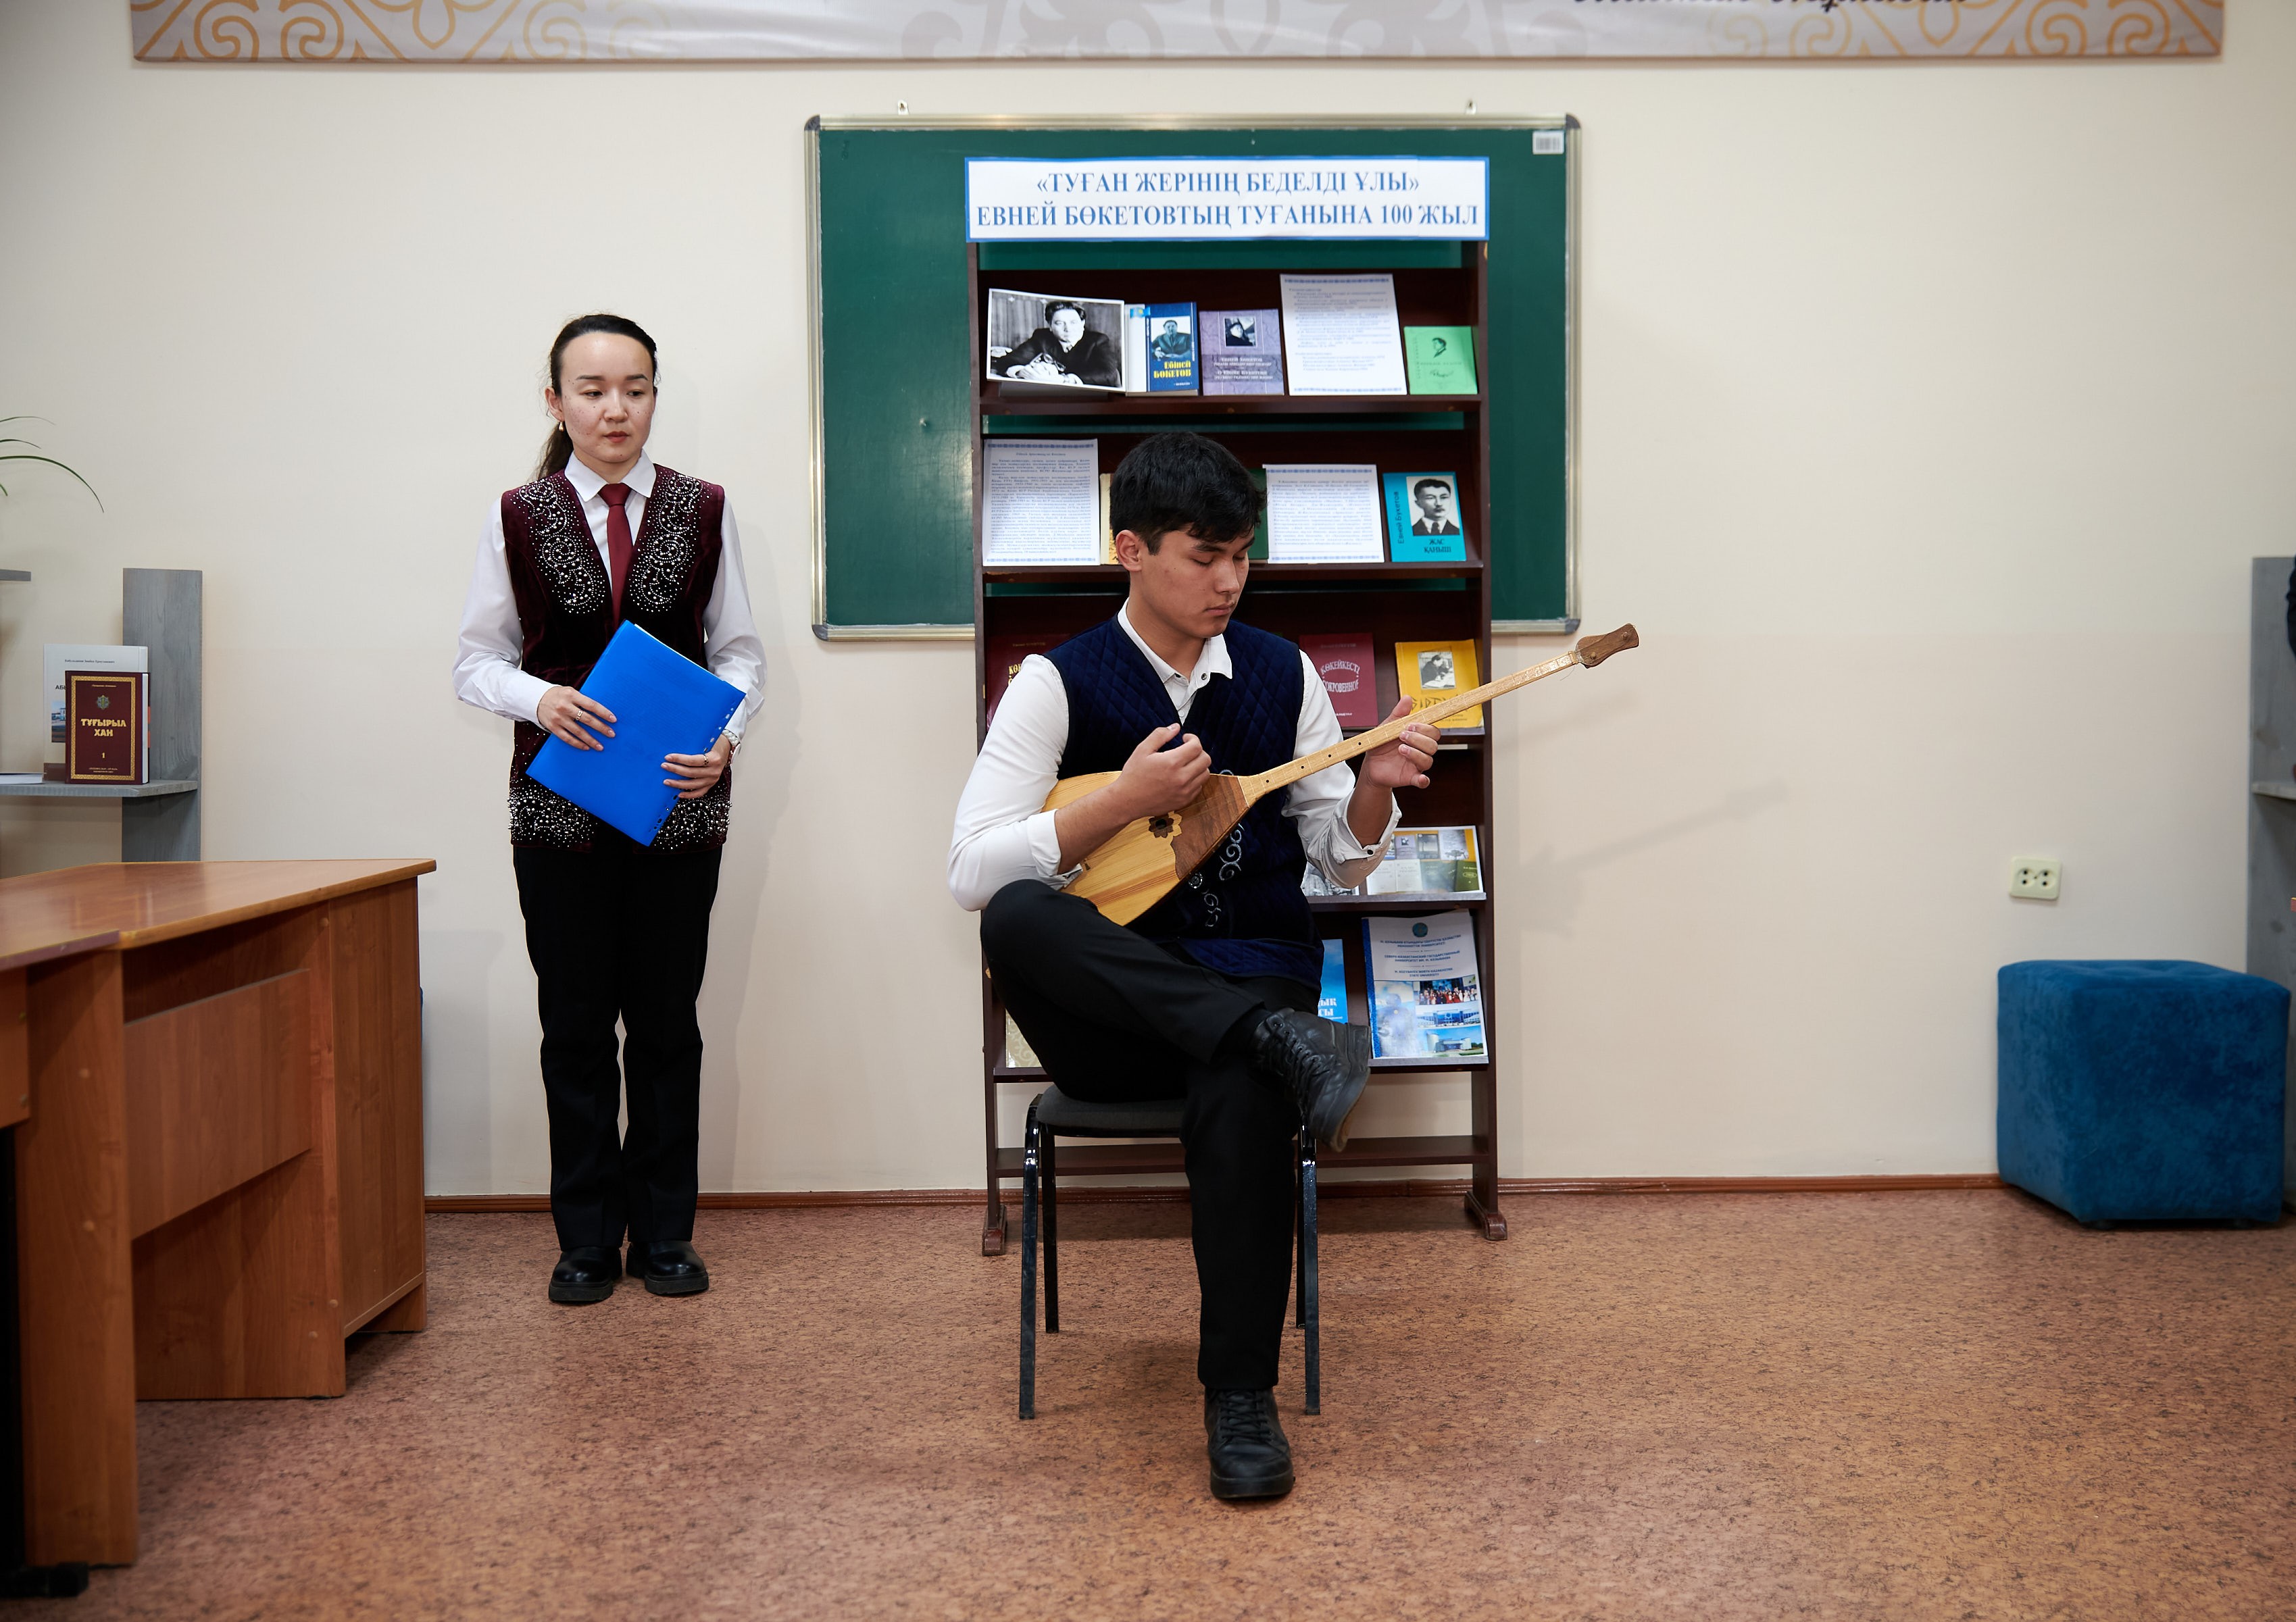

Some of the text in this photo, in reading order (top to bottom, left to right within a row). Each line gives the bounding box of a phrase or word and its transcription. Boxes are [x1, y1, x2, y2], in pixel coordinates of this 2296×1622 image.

[1037, 172, 1420, 196] «ТУҒАН ЖЕРІНІҢ БЕДЕЛДІ ҰЛЫ»
[976, 200, 1478, 230] ЕВНЕЙ БӨКЕТОВТЫҢ ТУҒАНЫНА 100 ЖЫЛ
[1394, 491, 1403, 521] Букетов
[1320, 659, 1360, 675] КӨКЕЙКЕСТІ
[81, 718, 126, 728] ТҰҒЫРЫЛ
[94, 728, 114, 737] ХАН
